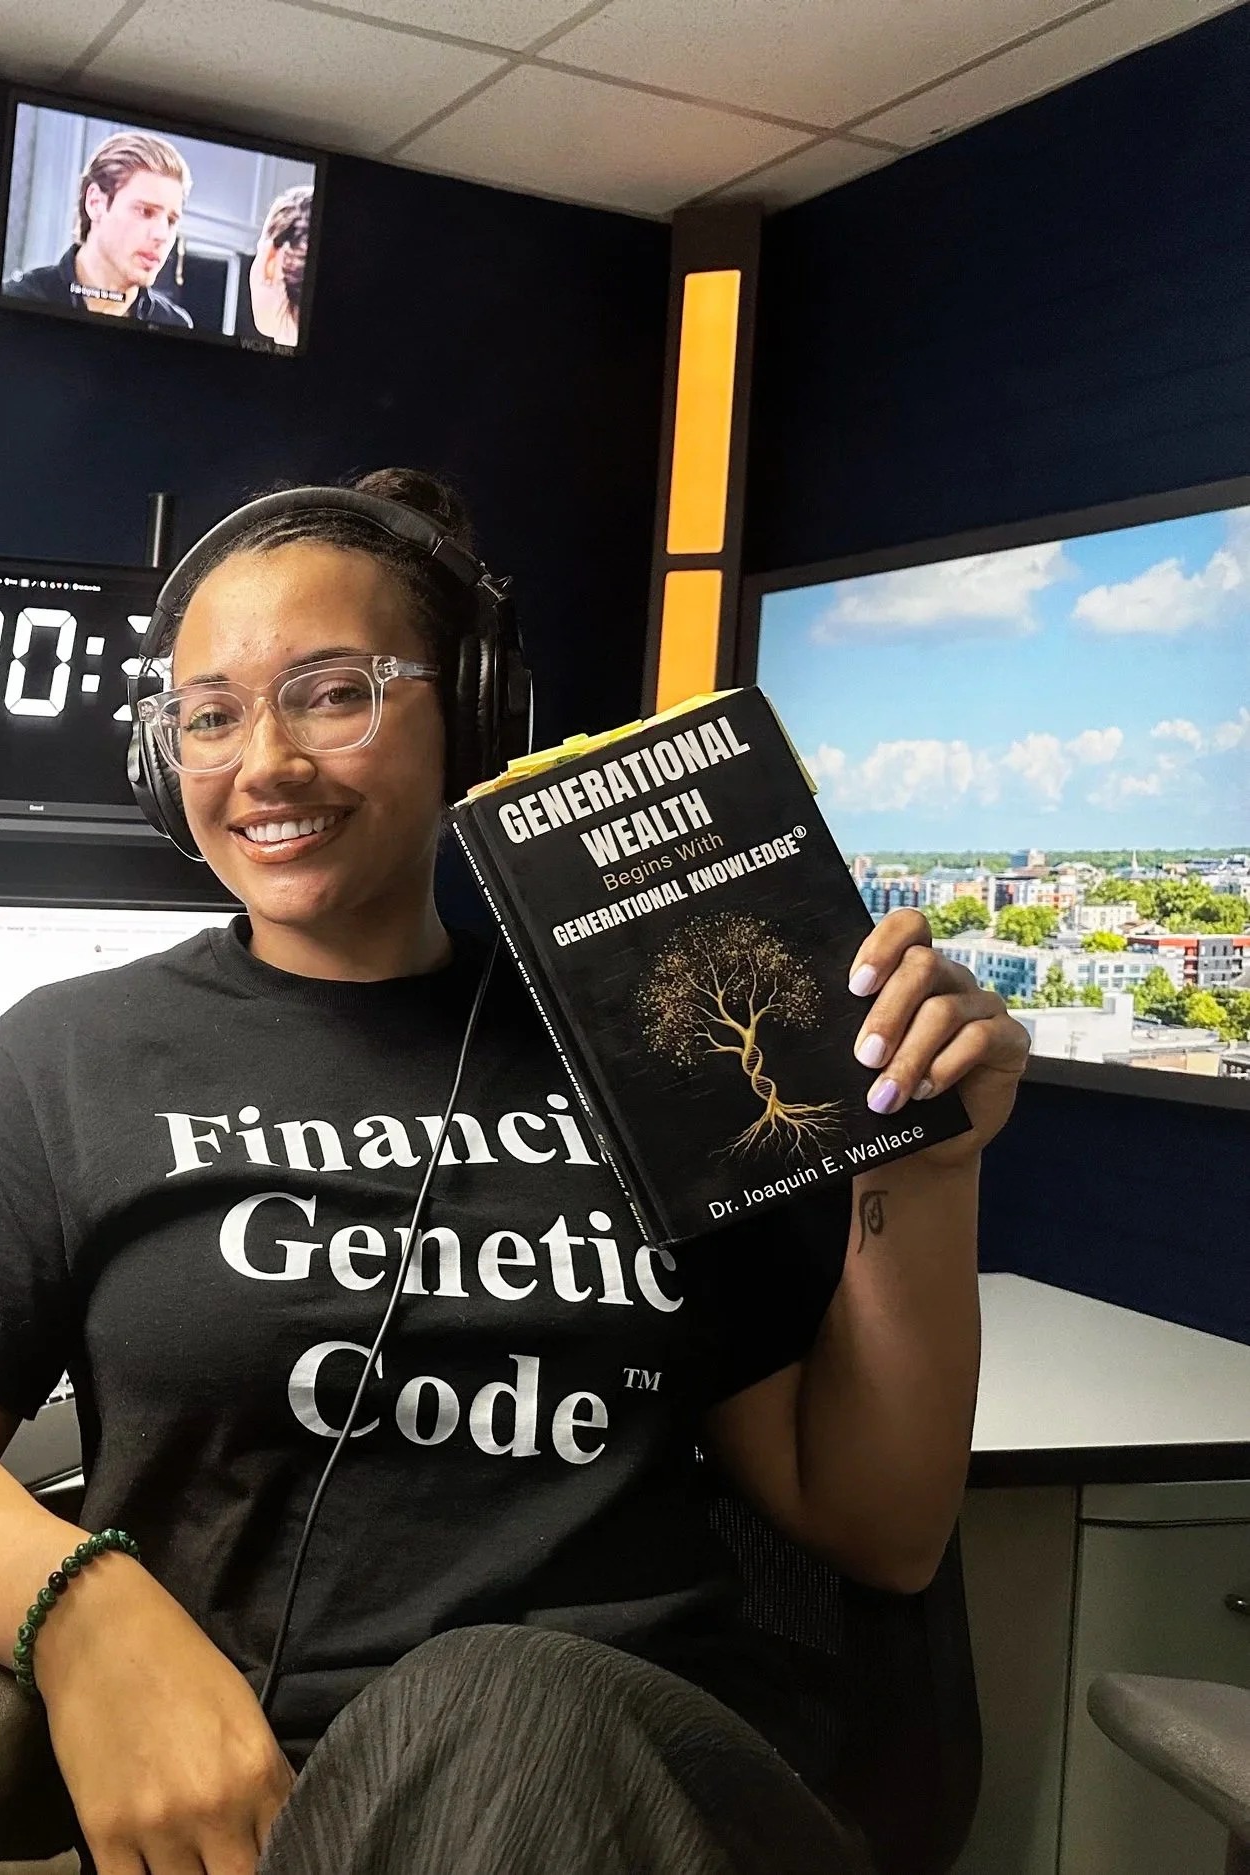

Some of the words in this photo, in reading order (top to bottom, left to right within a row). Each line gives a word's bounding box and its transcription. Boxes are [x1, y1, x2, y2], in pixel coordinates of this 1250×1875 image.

[498, 715, 750, 845] GENERATIONAL
[579, 788, 713, 869] WEALTH
[602, 853, 673, 892] Begins
[674, 831, 725, 863] With
[552, 879, 688, 947] GENERATIONAL
[154, 1093, 610, 1178] Financi
[708, 1197, 740, 1219] Dr.
[742, 1163, 820, 1207] Joaquin
[823, 1155, 844, 1178] E.
[844, 1123, 926, 1165] Wallace
[219, 1191, 684, 1313] Genetic
[288, 1340, 609, 1465] Code
